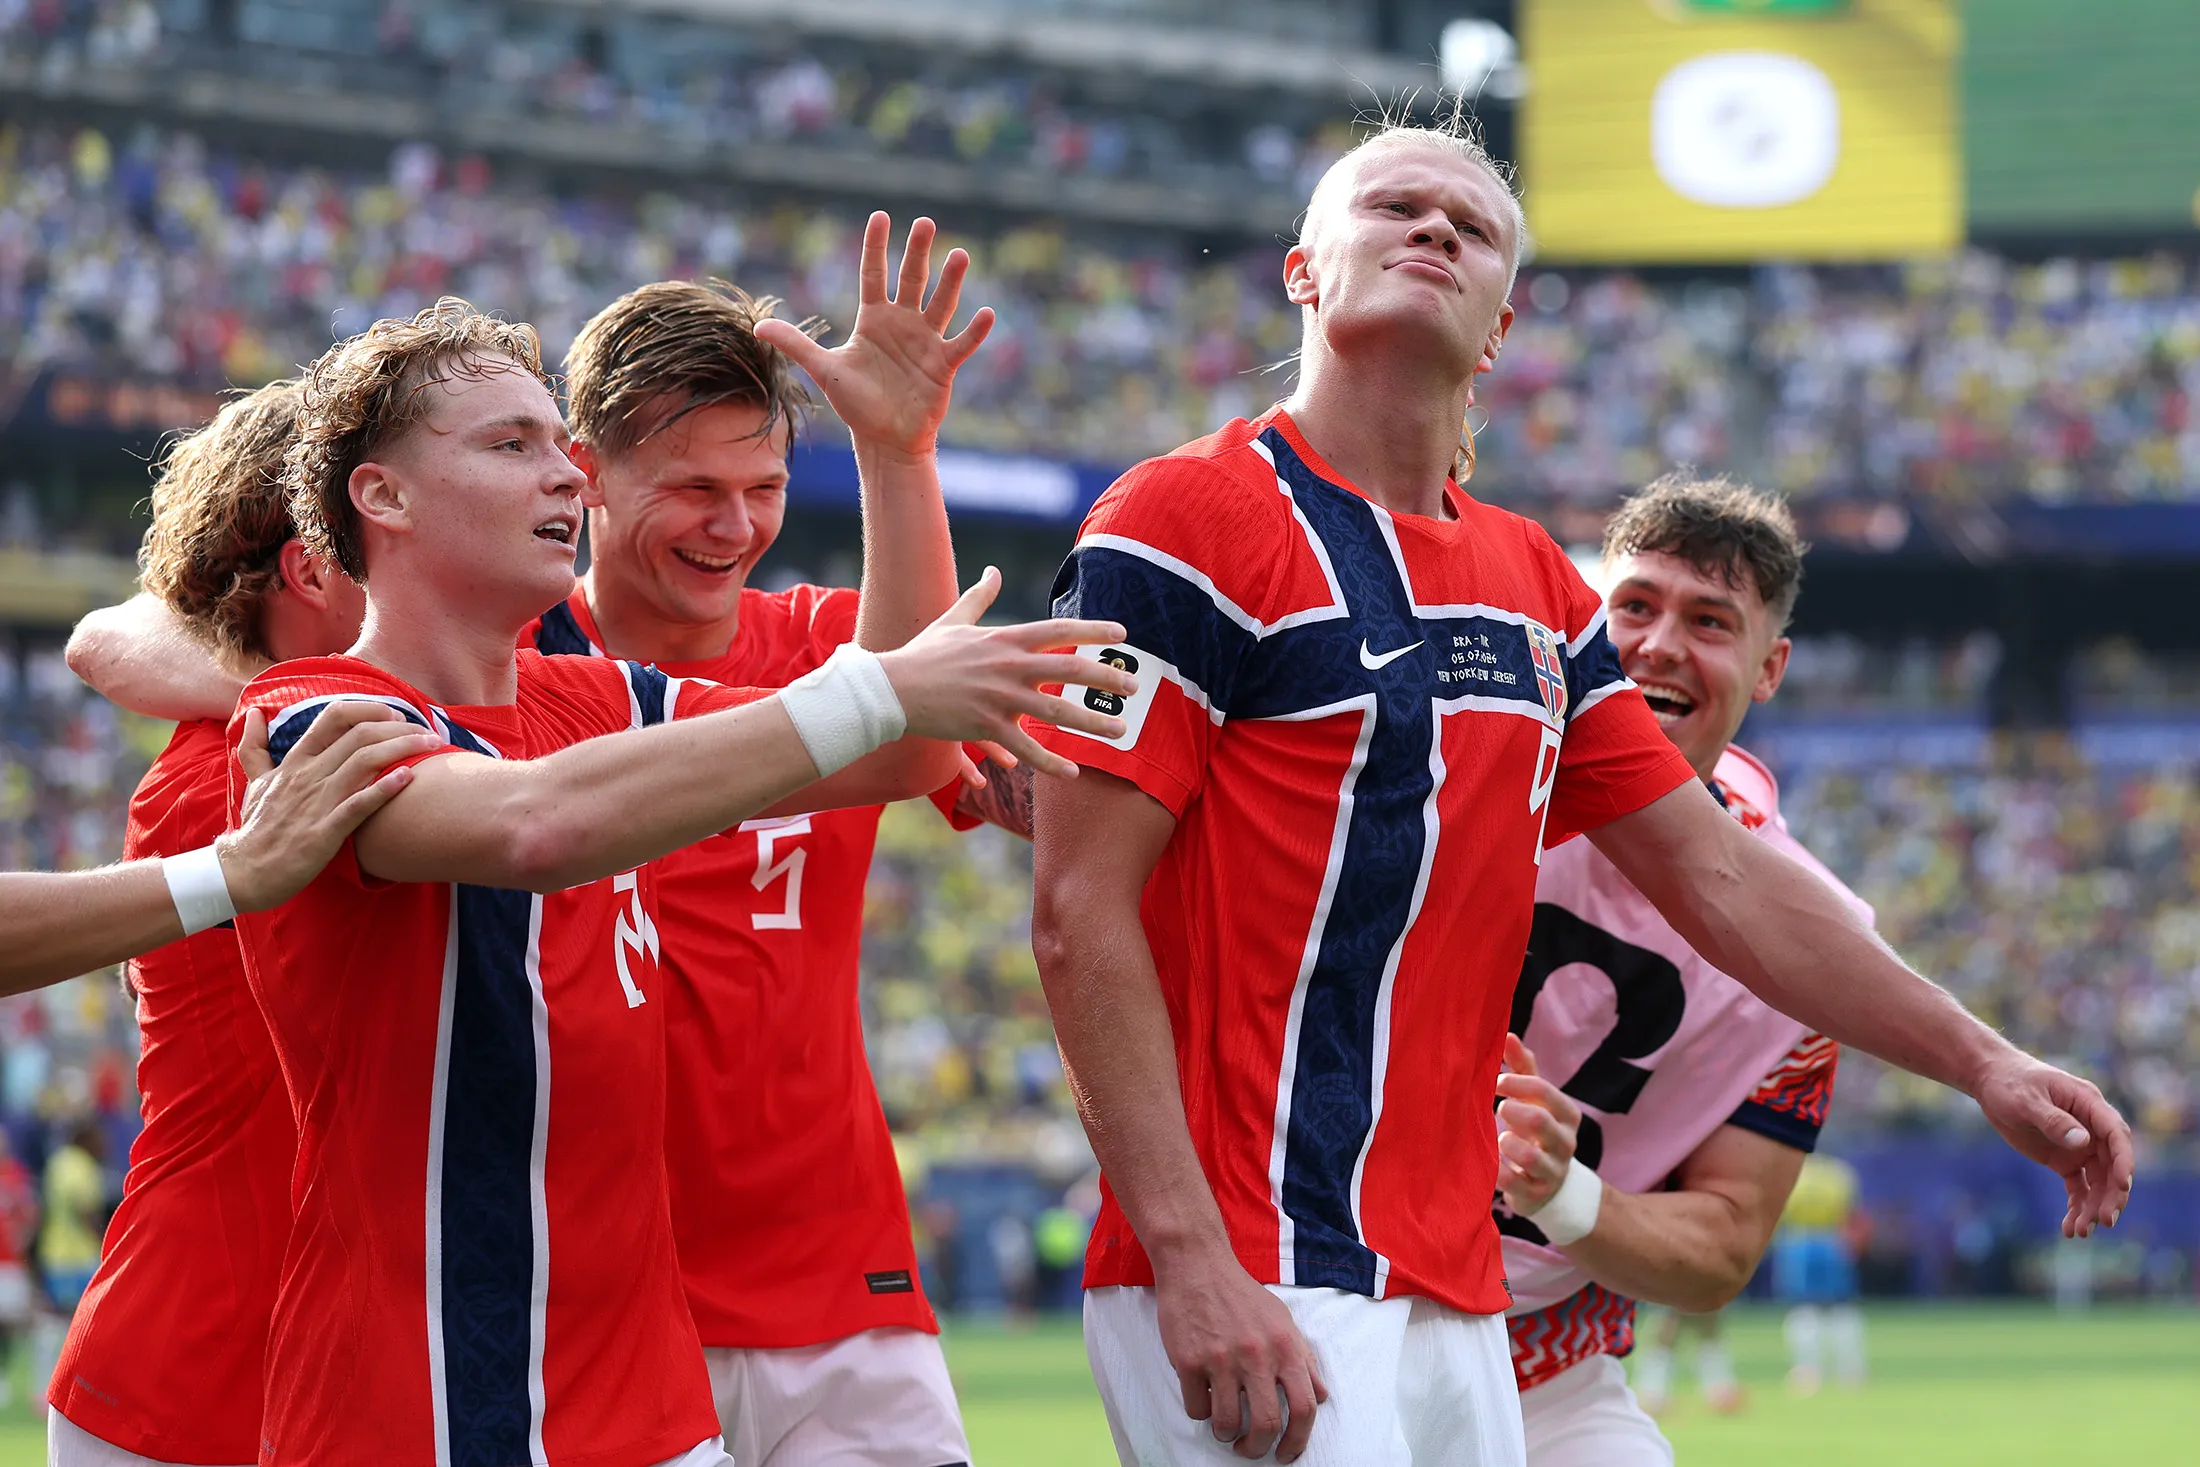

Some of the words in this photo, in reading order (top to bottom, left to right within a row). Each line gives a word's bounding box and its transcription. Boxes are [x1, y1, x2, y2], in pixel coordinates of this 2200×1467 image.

[1453, 635, 1472, 648] BRA
[1451, 650, 1497, 664] 05.07.026
[1452, 667, 1477, 682] YORK
[1492, 671, 1516, 685] JERSEY
[1093, 698, 1113, 711] FIFA
[750, 817, 812, 931] 5
